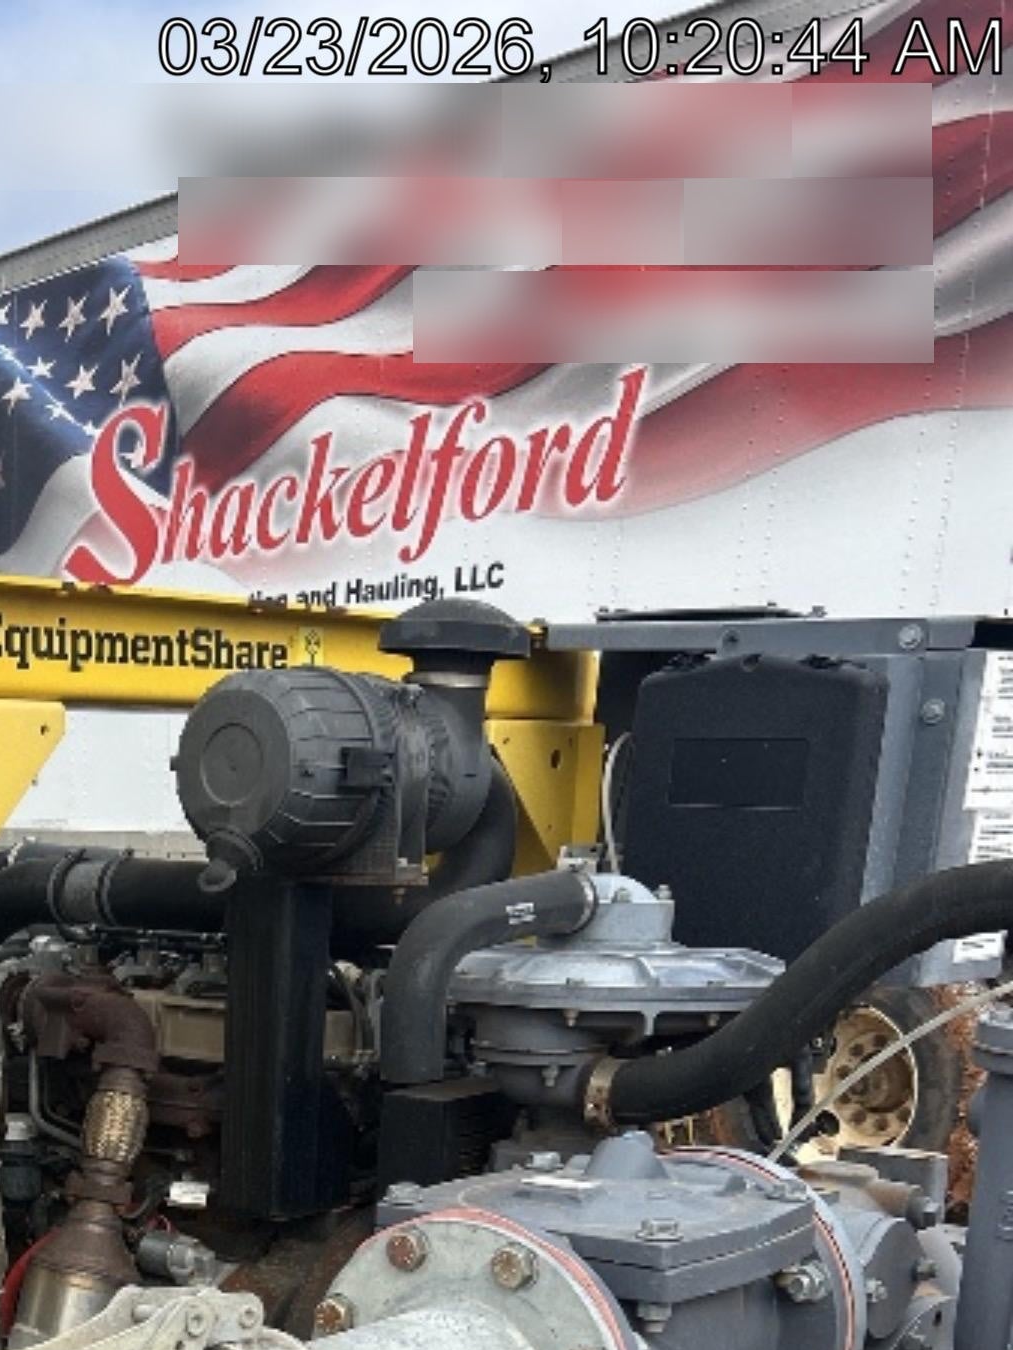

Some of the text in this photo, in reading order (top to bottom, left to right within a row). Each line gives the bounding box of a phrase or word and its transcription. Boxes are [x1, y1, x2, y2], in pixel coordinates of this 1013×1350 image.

[63, 365, 649, 586] Shackelford
[296, 581, 337, 607] and
[347, 573, 444, 604] Hauling,
[455, 561, 504, 592] LLC
